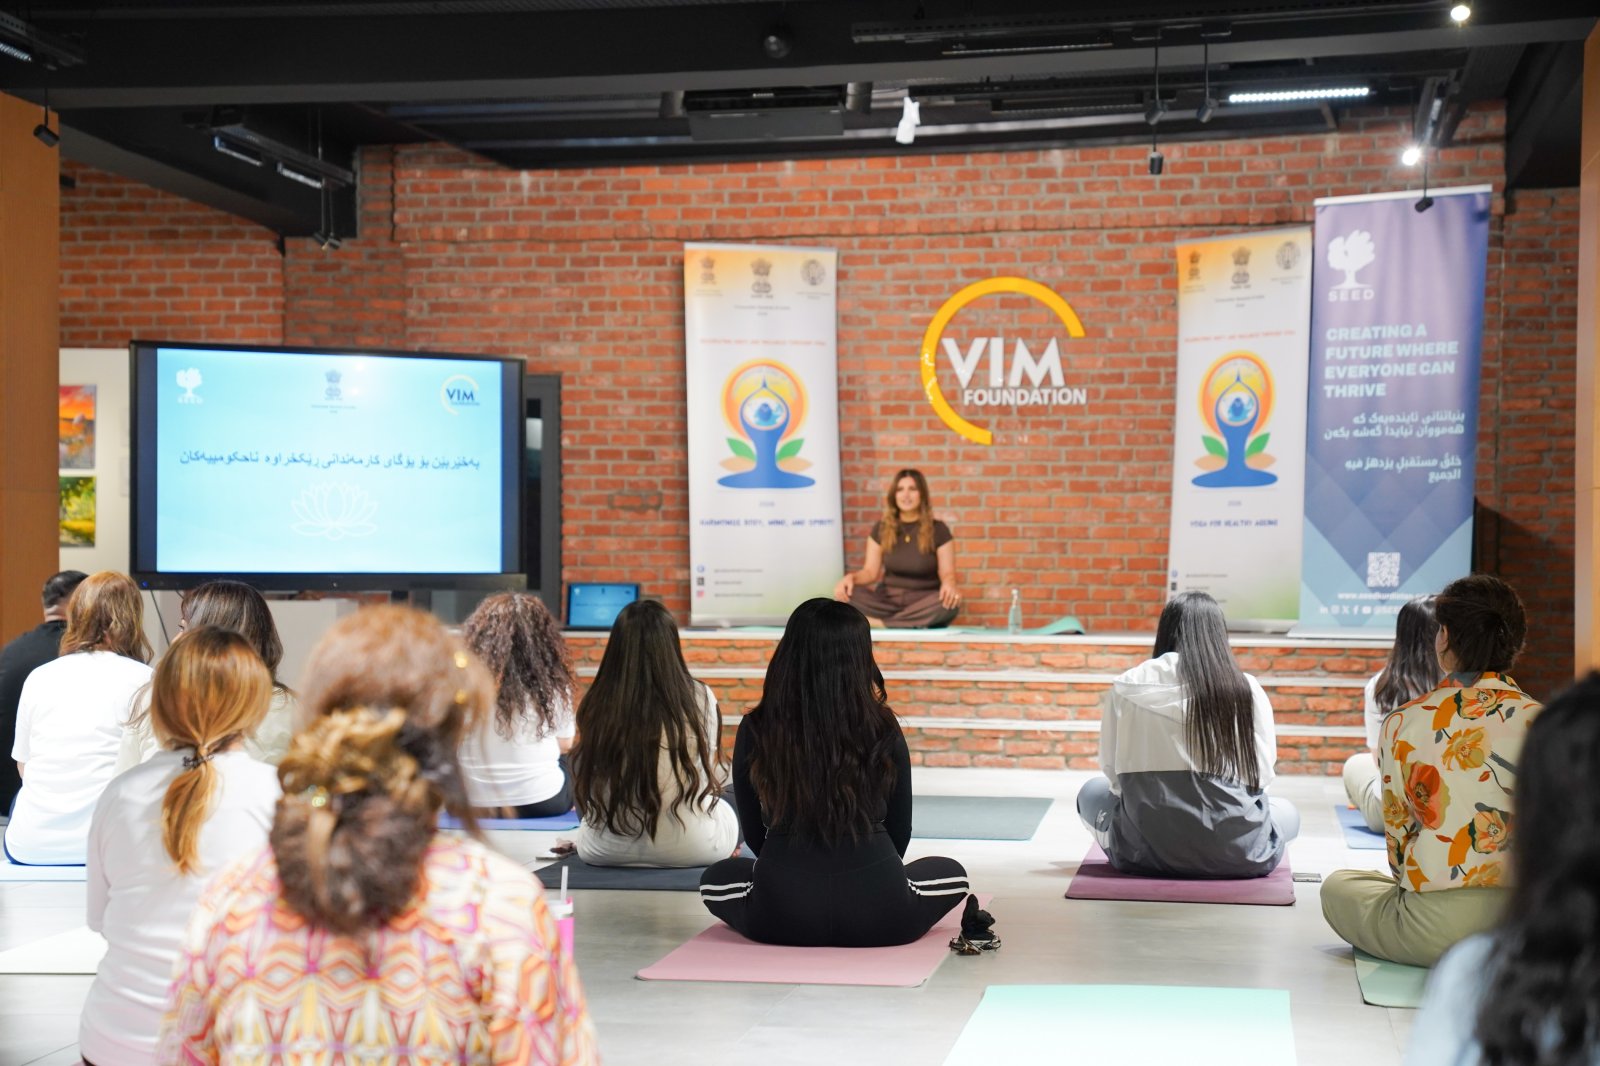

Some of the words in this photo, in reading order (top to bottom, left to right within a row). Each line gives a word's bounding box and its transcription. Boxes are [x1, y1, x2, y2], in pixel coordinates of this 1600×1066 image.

[1328, 289, 1374, 302] SEED
[1326, 325, 1412, 342] CREATING
[1415, 324, 1427, 337] A
[1325, 344, 1393, 361] FUTURE
[1396, 341, 1459, 357] WHERE
[941, 337, 1065, 389] VIM
[1324, 364, 1415, 380] EVERYONE
[1419, 361, 1455, 375] CAN
[446, 388, 475, 401] VIM
[964, 388, 1087, 406] FOUNDATION
[1324, 383, 1386, 399] THRIVE
